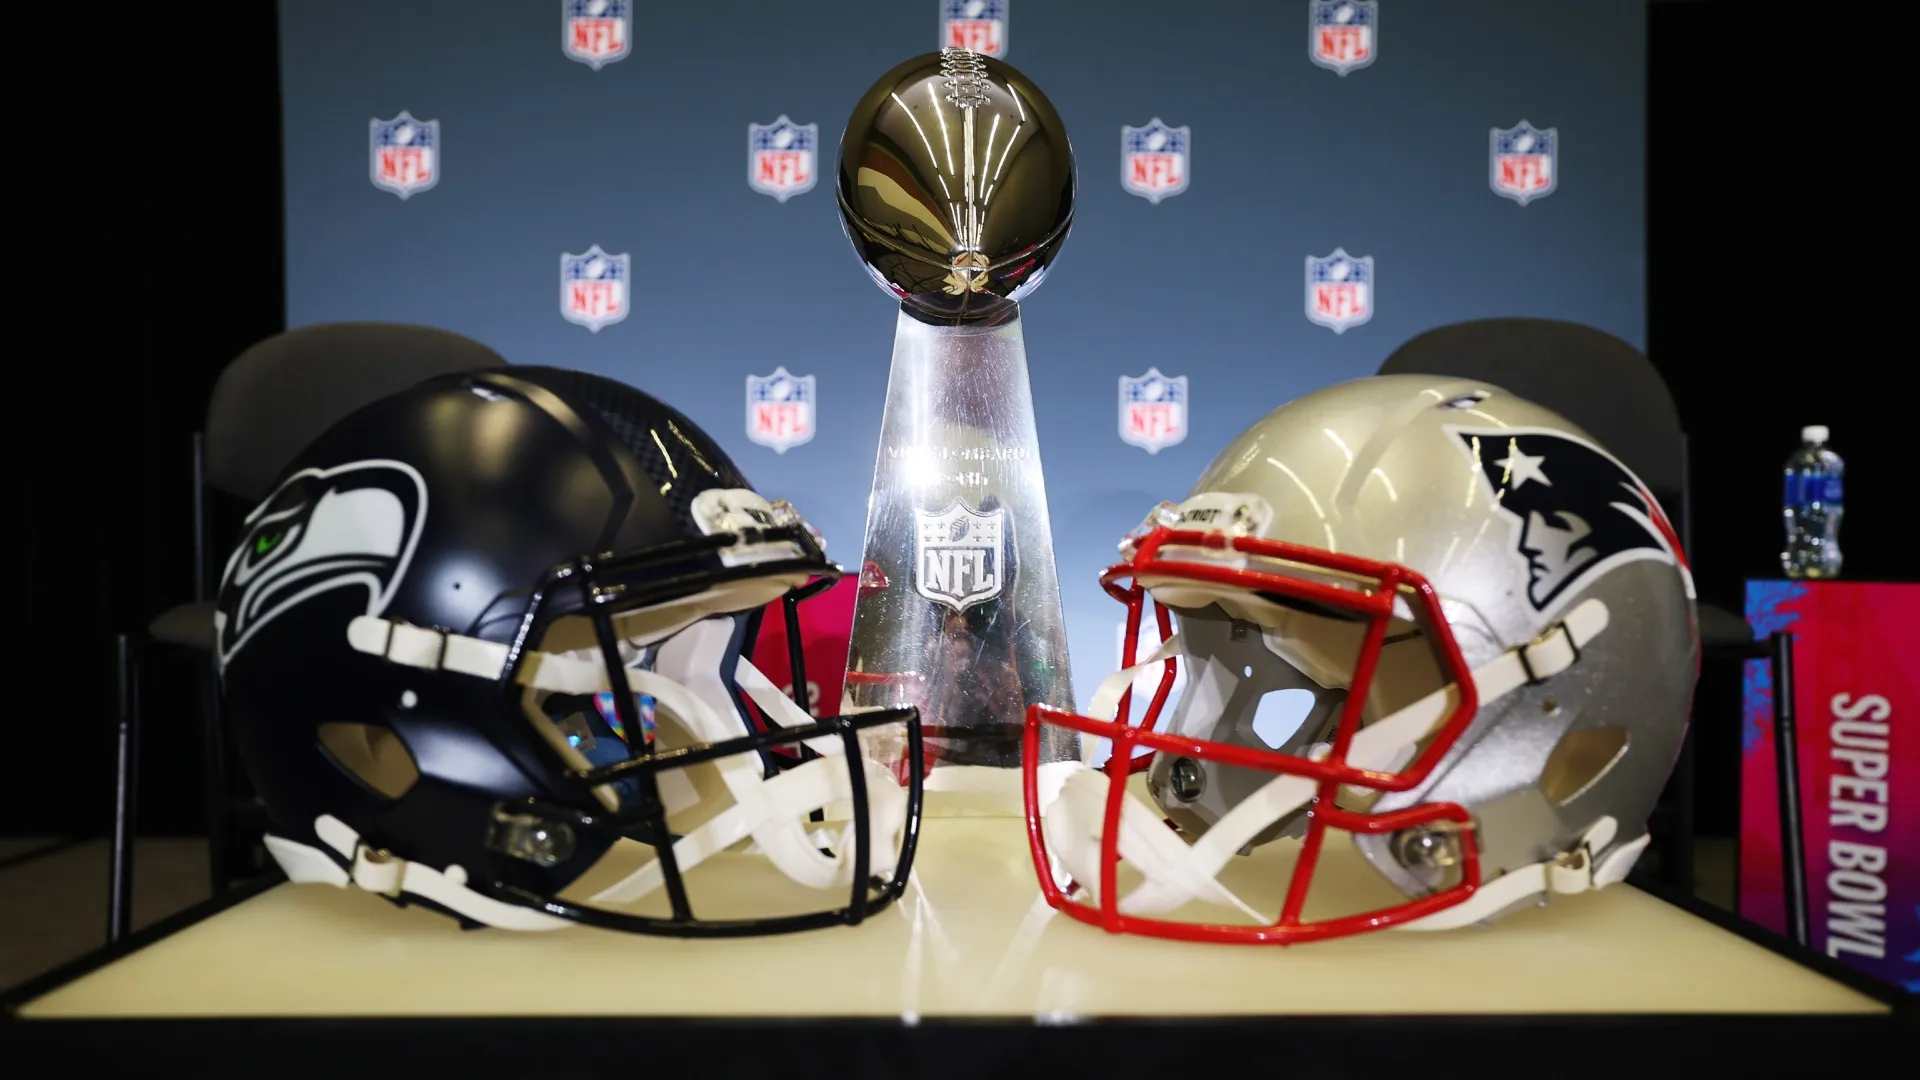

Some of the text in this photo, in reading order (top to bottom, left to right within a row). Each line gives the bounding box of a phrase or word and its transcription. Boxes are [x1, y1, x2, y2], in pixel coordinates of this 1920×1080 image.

[572, 18, 623, 54] NFL
[949, 21, 999, 54] NFL
[1319, 25, 1370, 61] NFL
[380, 147, 431, 183] NFL
[759, 150, 808, 185] NFL
[1132, 153, 1180, 188] NFL
[1500, 155, 1550, 190] NFL
[571, 281, 619, 315] NFL
[1316, 283, 1363, 317] NFL
[757, 404, 805, 436] NFL
[1130, 405, 1178, 436] NFL
[925, 549, 995, 597] NFL
[1826, 691, 1892, 960] SUPER BOWL
